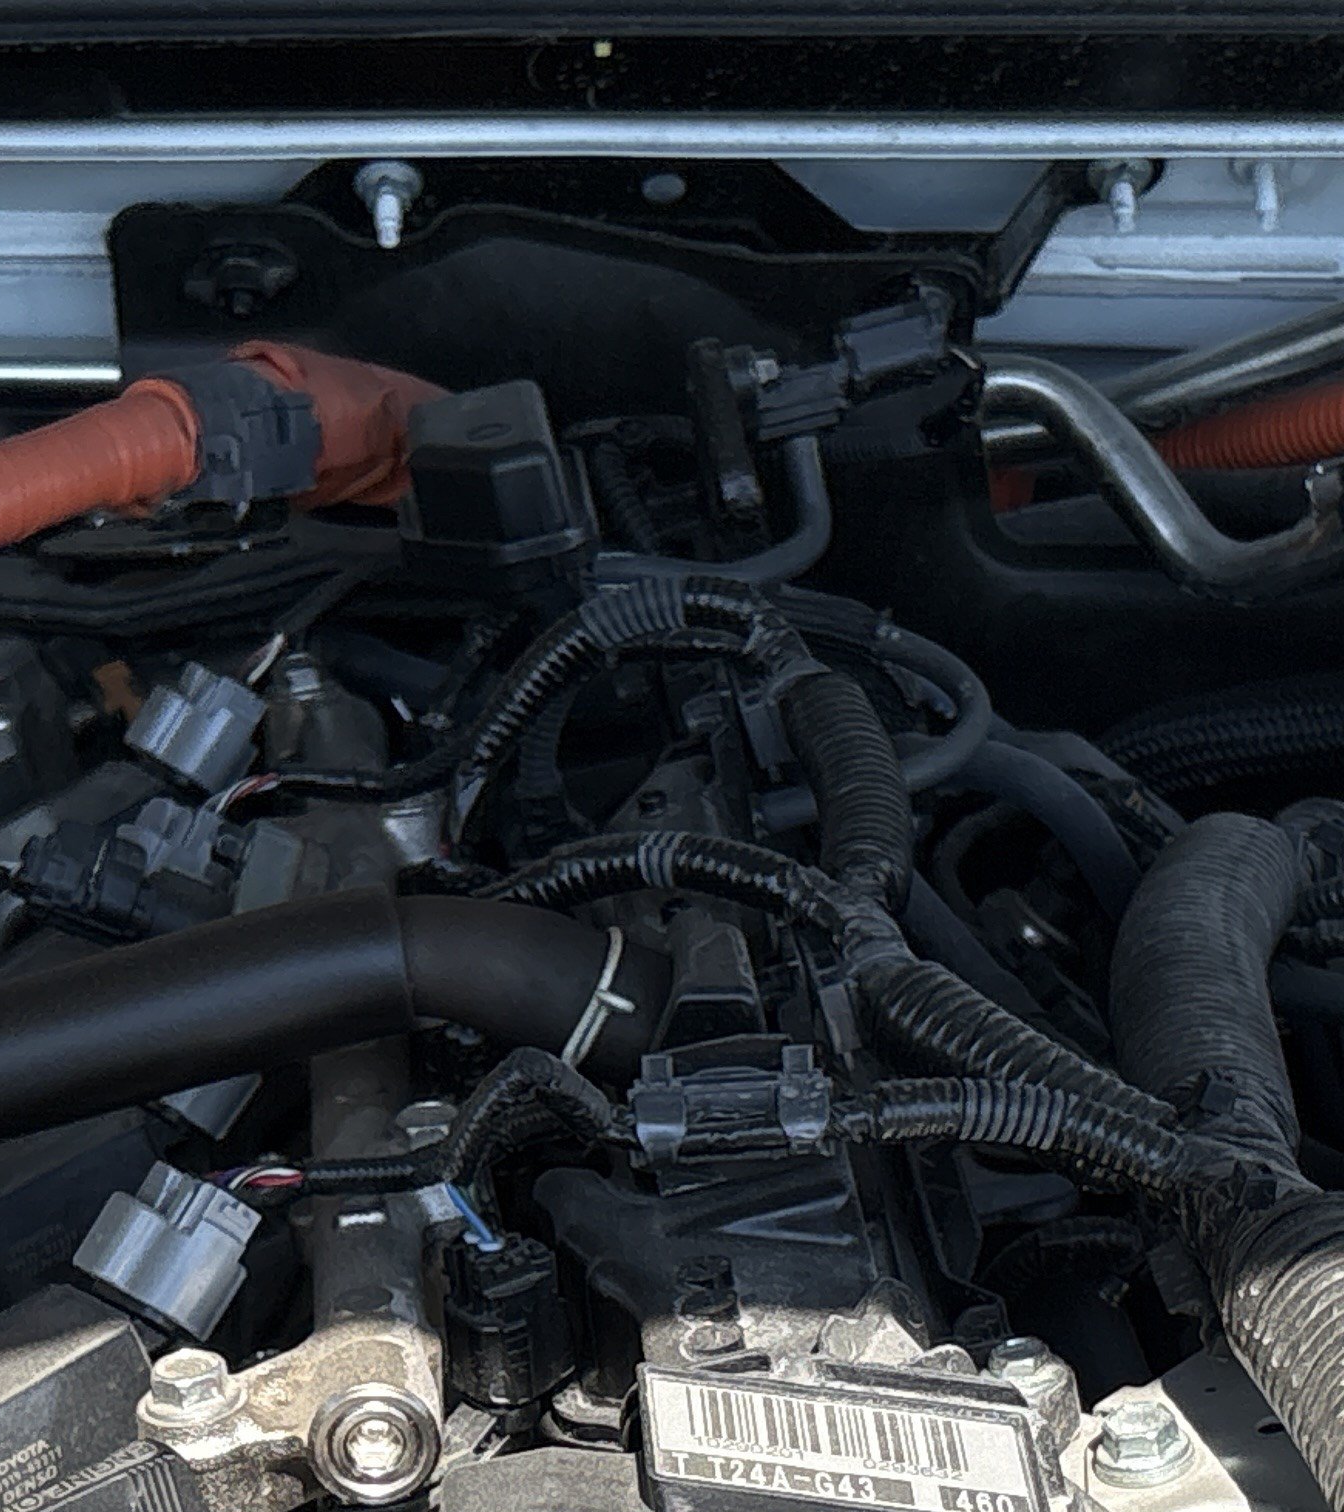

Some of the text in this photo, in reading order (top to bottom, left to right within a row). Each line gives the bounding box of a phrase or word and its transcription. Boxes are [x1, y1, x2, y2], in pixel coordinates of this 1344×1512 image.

[3, 1465, 58, 1505] DENSO
[49, 1439, 158, 1499] ENGINE
[671, 1452, 690, 1477] T
[708, 1456, 877, 1502] T24A-G43
